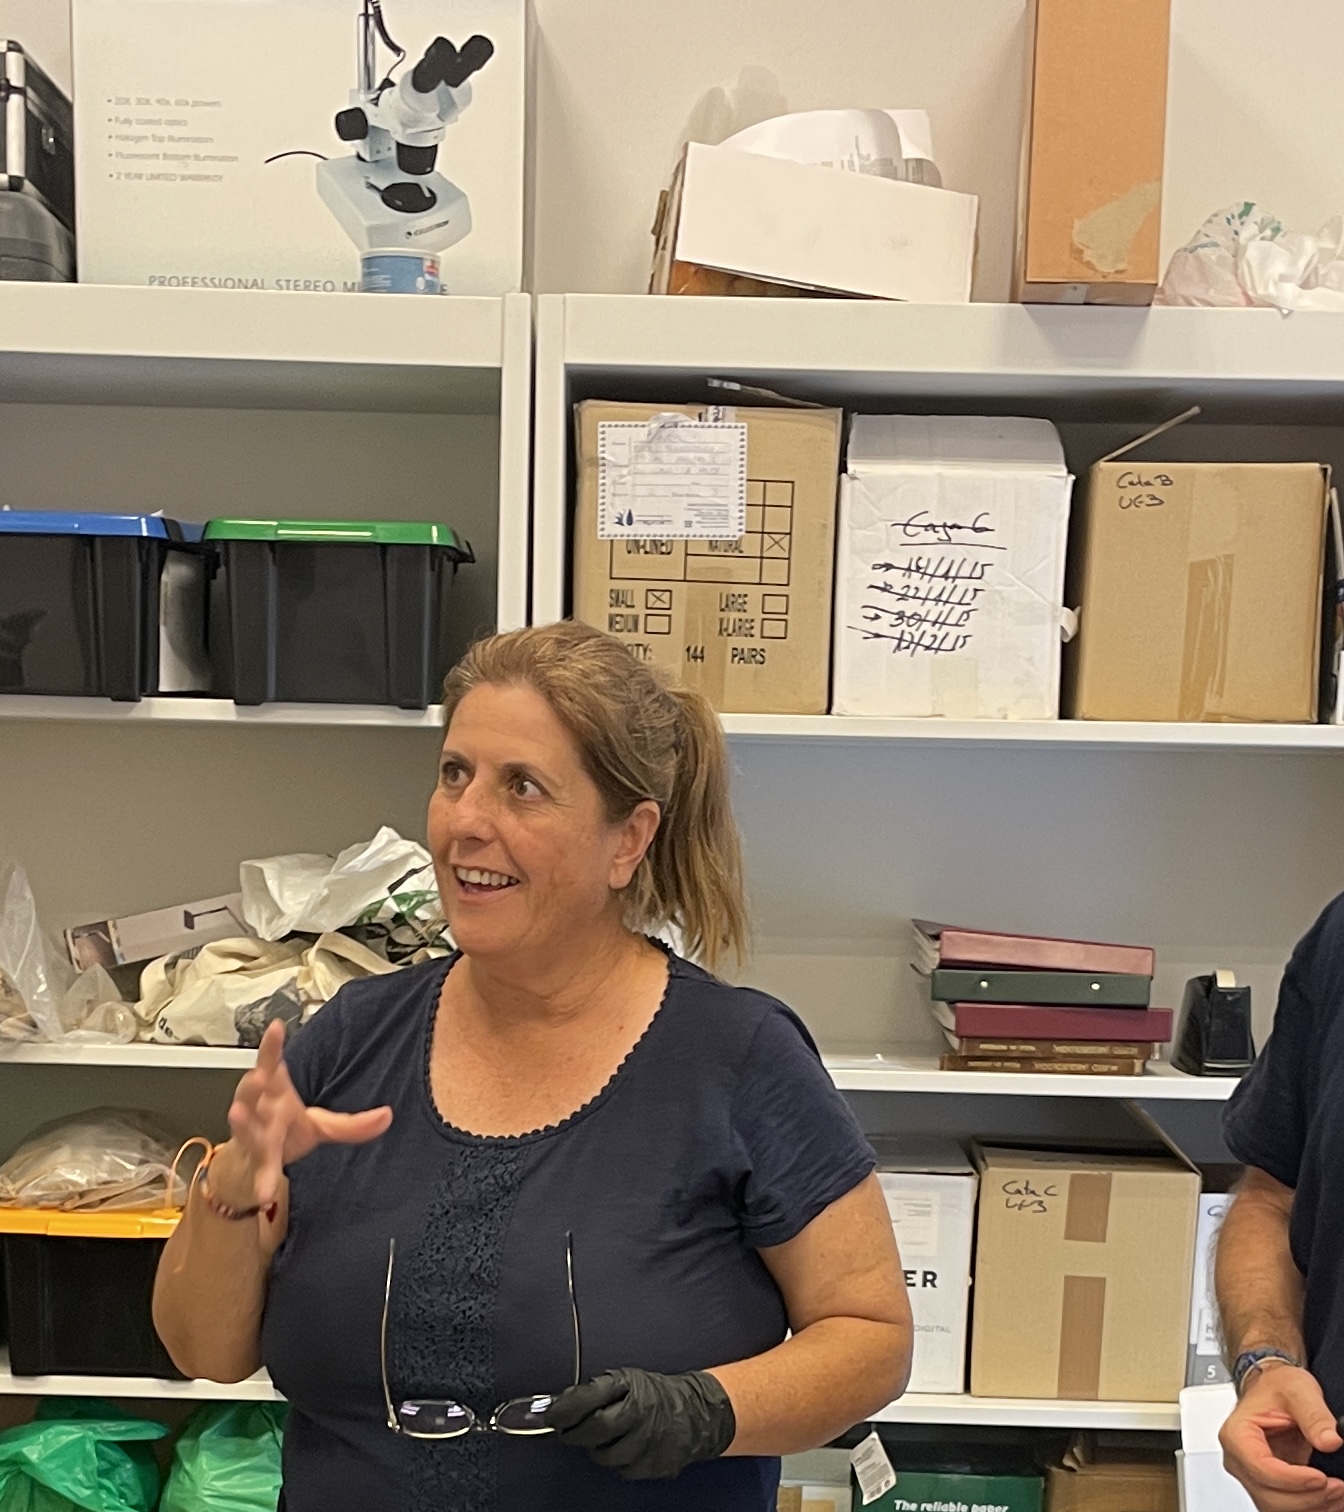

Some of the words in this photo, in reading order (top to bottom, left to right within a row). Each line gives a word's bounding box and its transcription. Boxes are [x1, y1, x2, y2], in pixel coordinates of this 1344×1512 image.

[275, 278, 336, 293] STEREO
[608, 588, 636, 609] SMALL
[719, 592, 749, 613] LARGE
[607, 613, 640, 633] MEDIUM
[717, 617, 755, 638] X-LARGE
[685, 644, 705, 663] 144
[730, 647, 766, 665] PAIRS
[893, 1499, 918, 1512] The
